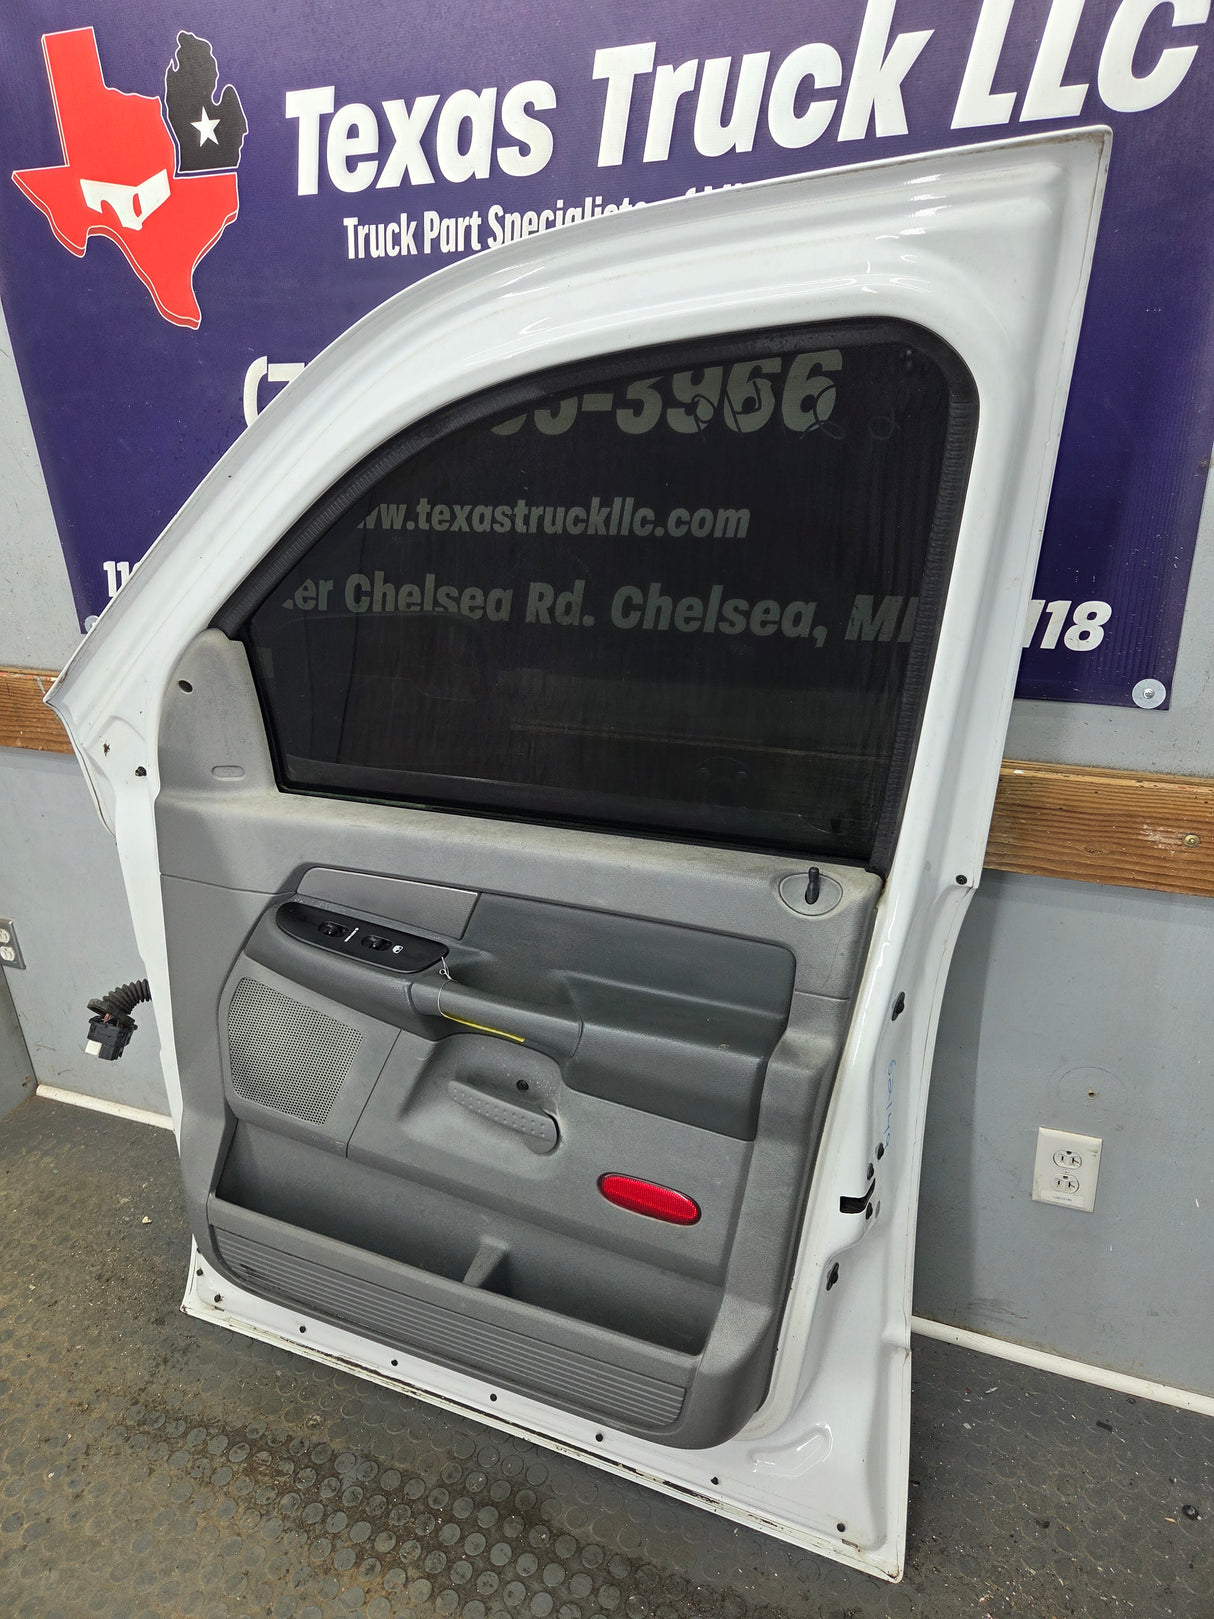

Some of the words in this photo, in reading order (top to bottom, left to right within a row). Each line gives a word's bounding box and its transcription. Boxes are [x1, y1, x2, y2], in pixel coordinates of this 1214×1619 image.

[285, 79, 557, 196] Texas
[591, 0, 935, 167] Truck
[950, 0, 1212, 130] LLC
[343, 215, 418, 260] Truck
[423, 208, 482, 255] Part
[103, 560, 141, 598] 11
[344, 570, 512, 622] Chelsea
[525, 580, 595, 627] Rd.
[610, 582, 828, 648] Chelsea,
[844, 594, 919, 643] MI
